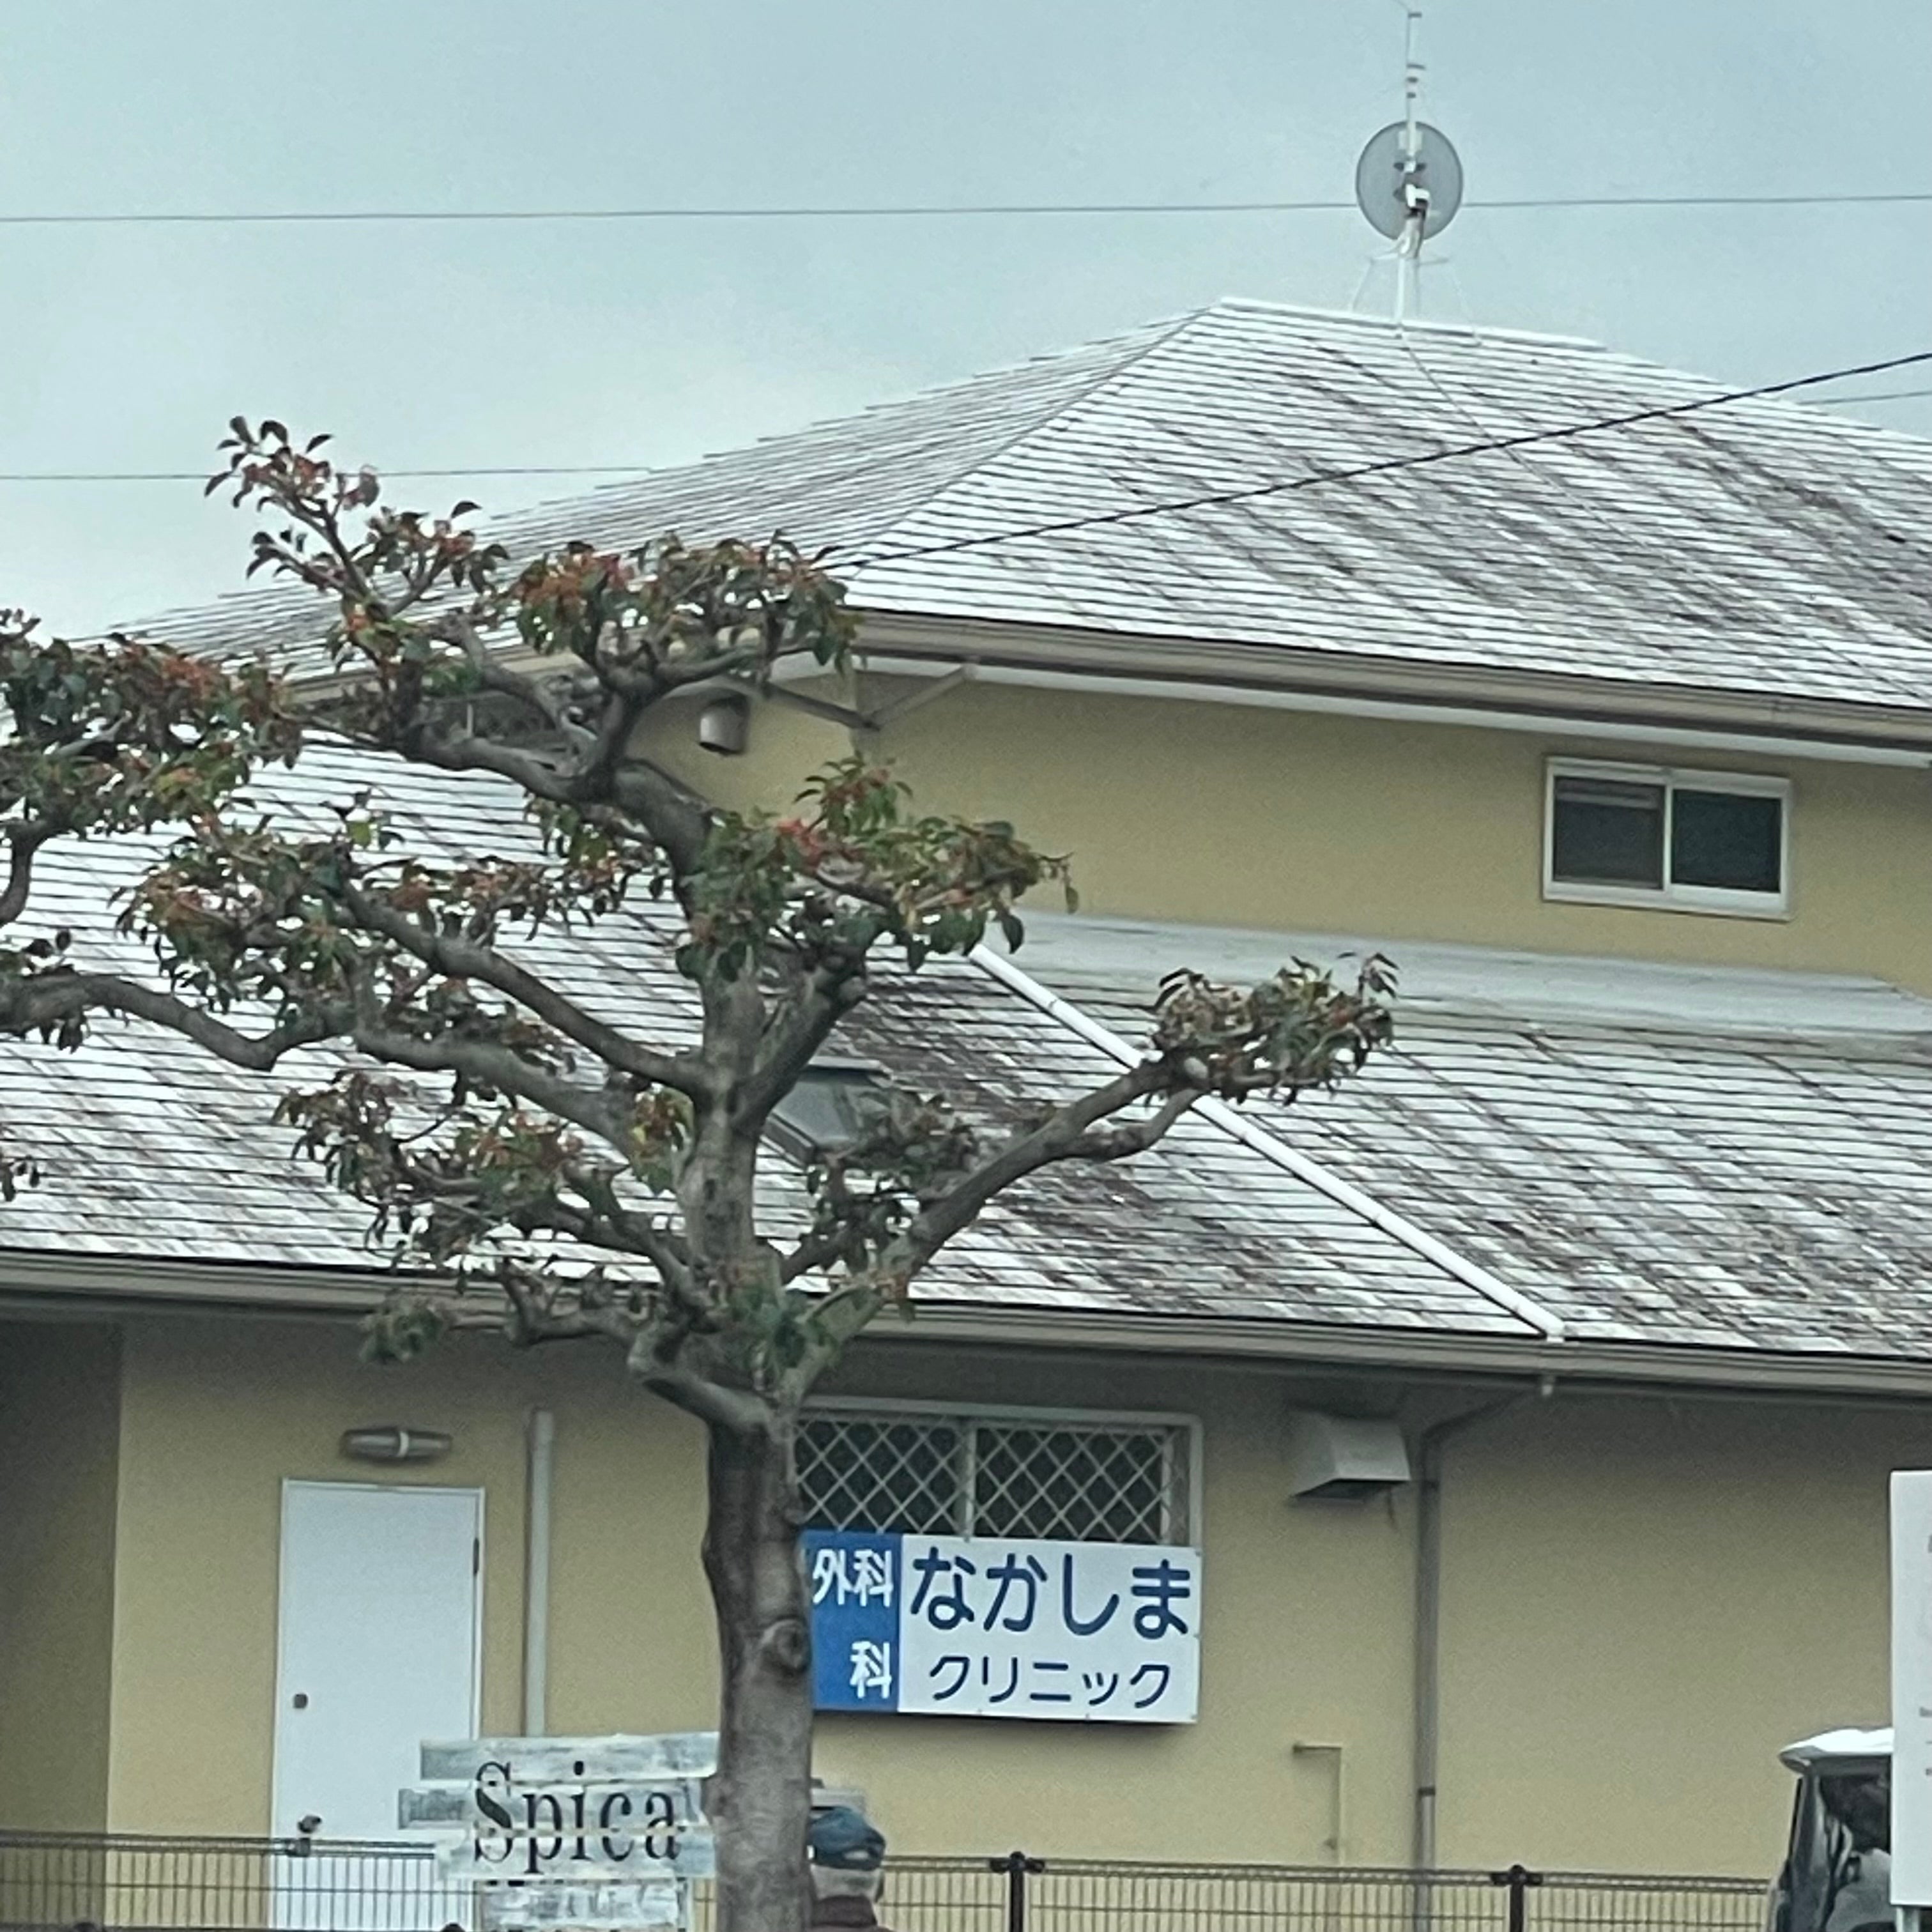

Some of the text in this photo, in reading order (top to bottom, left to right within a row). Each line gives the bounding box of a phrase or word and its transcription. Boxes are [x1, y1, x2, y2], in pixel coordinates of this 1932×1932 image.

[910, 1547, 1191, 1639] なかしま
[930, 1656, 1170, 1708] クリニック
[474, 1761, 679, 1874] Spica
